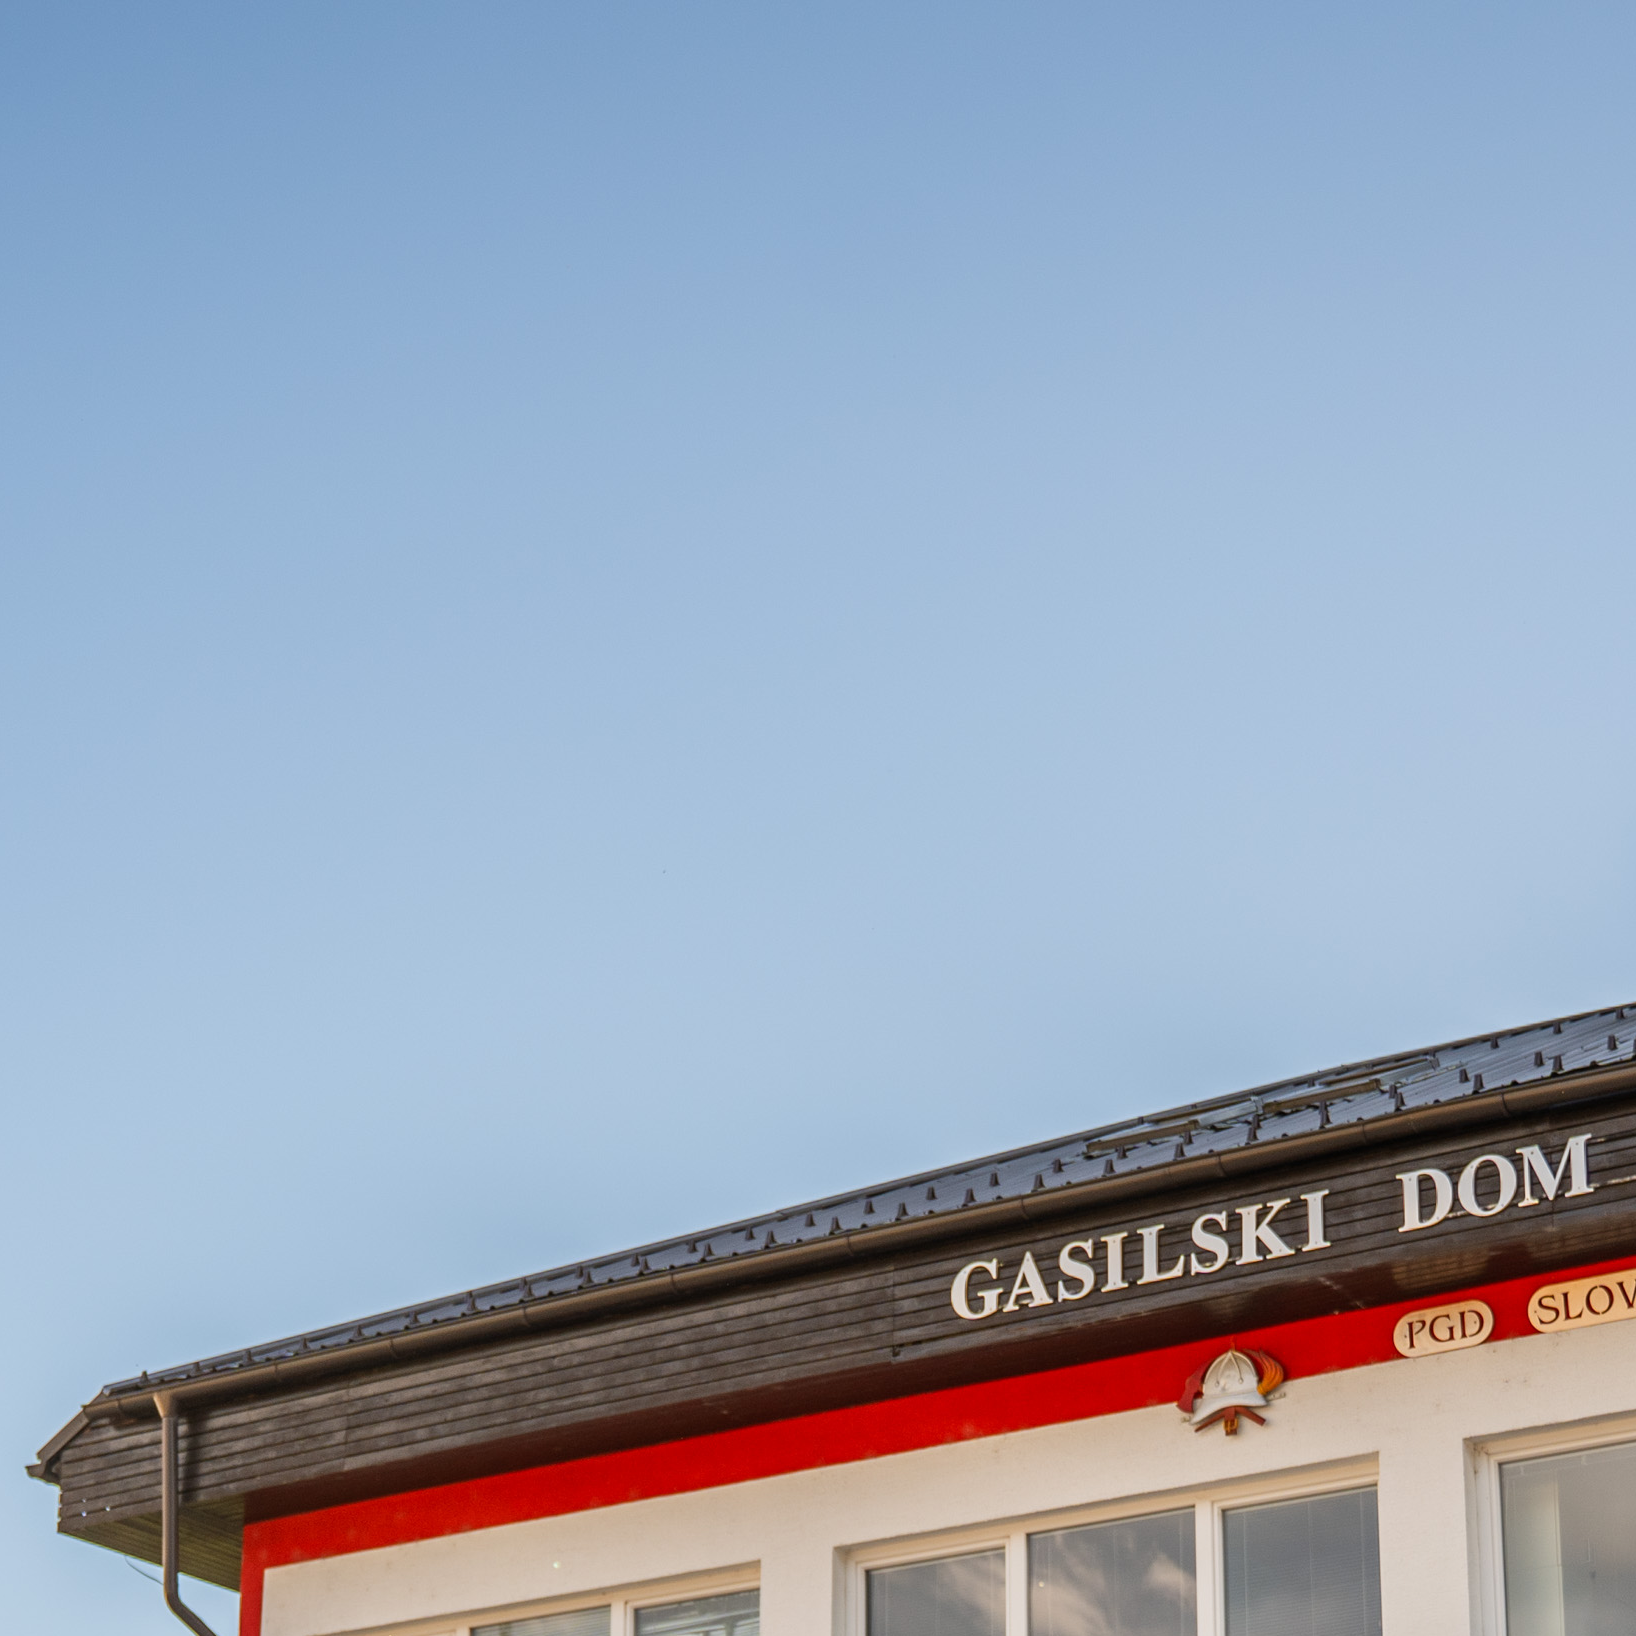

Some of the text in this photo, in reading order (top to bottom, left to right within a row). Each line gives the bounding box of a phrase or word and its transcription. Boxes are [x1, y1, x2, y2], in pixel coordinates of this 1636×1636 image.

[950, 1189, 1331, 1320] GASILSKI
[1395, 1133, 1594, 1232] DOM
[1405, 1308, 1486, 1350] PGD
